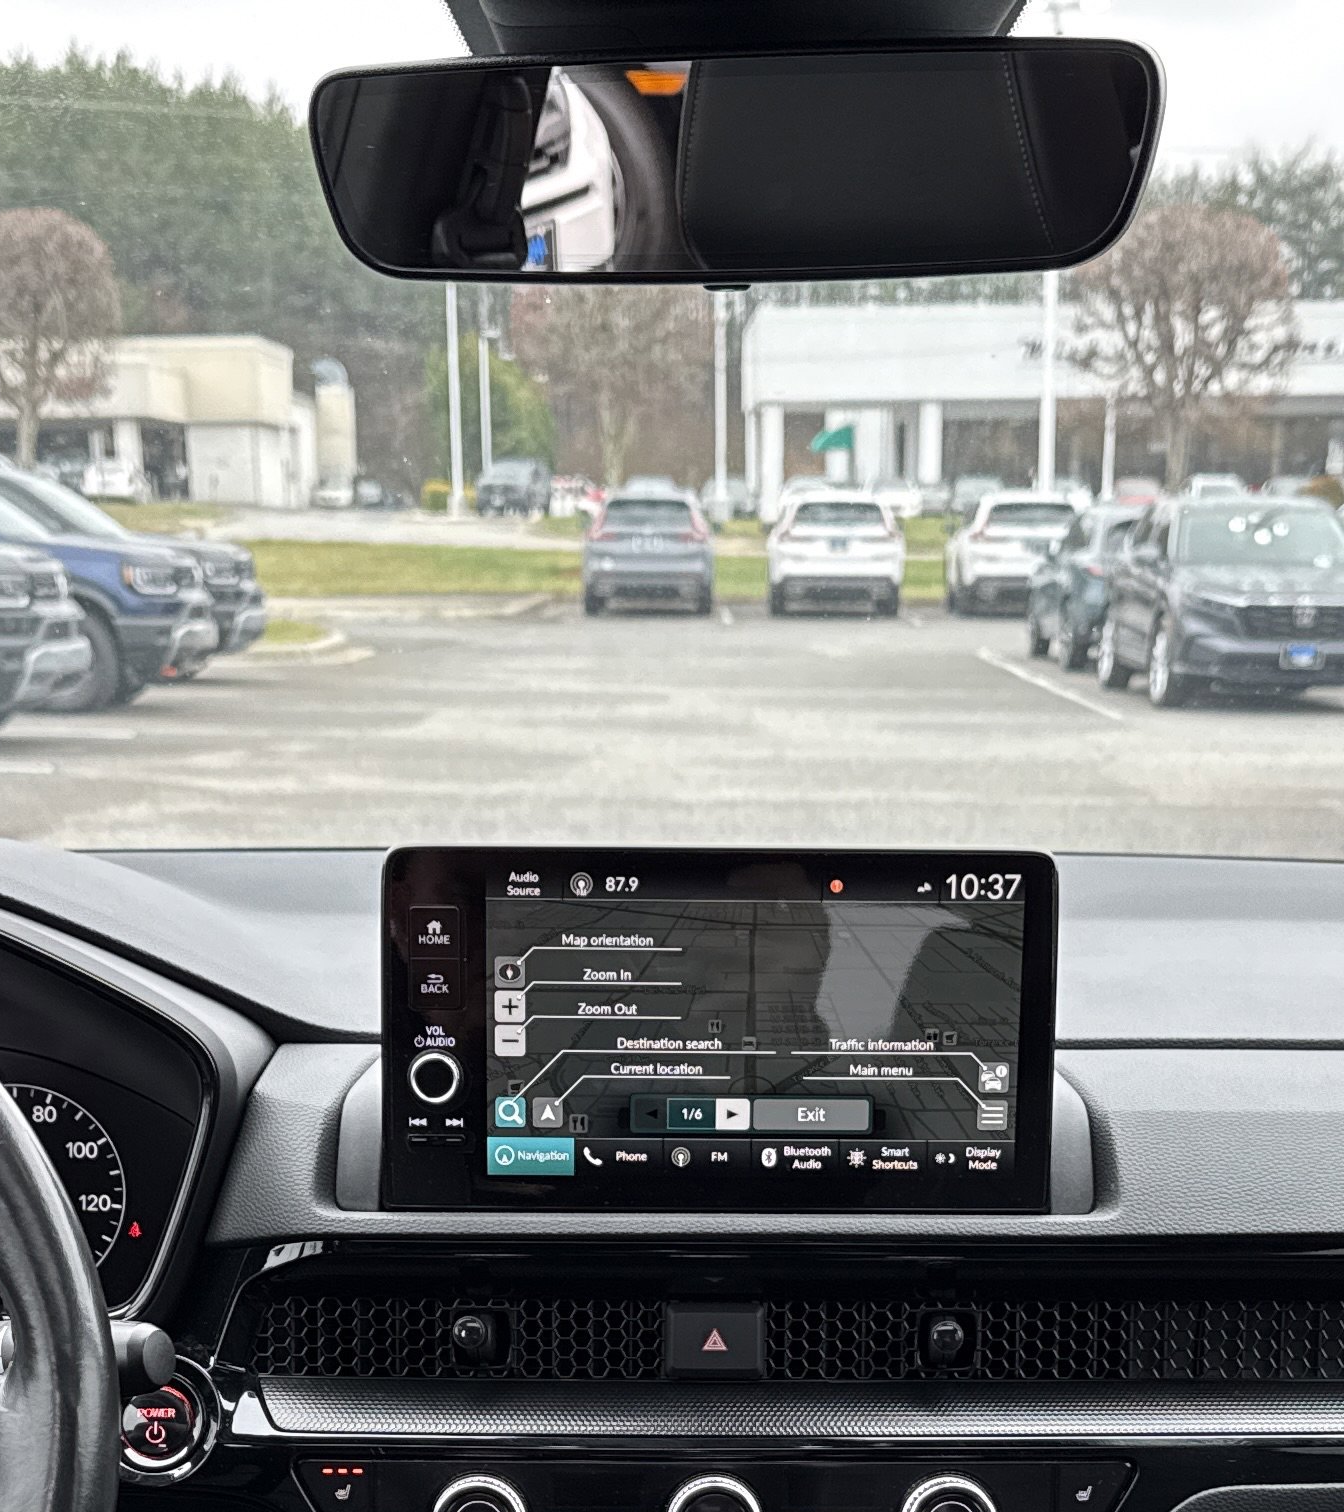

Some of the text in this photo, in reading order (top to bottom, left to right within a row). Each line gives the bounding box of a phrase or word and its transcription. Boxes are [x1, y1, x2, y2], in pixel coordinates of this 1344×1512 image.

[509, 871, 539, 883] Audio
[605, 876, 639, 892] 87.9
[945, 873, 1022, 900] 10:37
[507, 885, 541, 896] Source
[418, 935, 451, 945] HOME
[561, 933, 654, 947] Map orientation
[583, 968, 632, 980] Zoom In
[420, 984, 449, 994] BACK
[578, 1002, 638, 1014] Zoom Out
[425, 1026, 446, 1036] VOL
[426, 1037, 456, 1047] AUDIO
[616, 1037, 722, 1049] Destination search
[829, 1038, 934, 1050] Traffic information
[610, 1062, 703, 1075] Current location
[849, 1064, 913, 1076] Main menu
[32, 1105, 57, 1123] 80
[681, 1107, 703, 1120] 1/6
[797, 1106, 826, 1122] Exit
[65, 1141, 98, 1159] 100
[783, 1146, 832, 1157] Bluetooth
[880, 1146, 910, 1157] Smart
[965, 1147, 1002, 1159] Display
[517, 1150, 570, 1163] Navigation
[615, 1151, 648, 1163] Phone
[710, 1151, 728, 1162] FM
[792, 1158, 822, 1169] Audio
[872, 1159, 918, 1170] Shortcuts
[968, 1159, 998, 1170] Mode
[78, 1194, 111, 1211] 120
[136, 1408, 176, 1419] POWER
